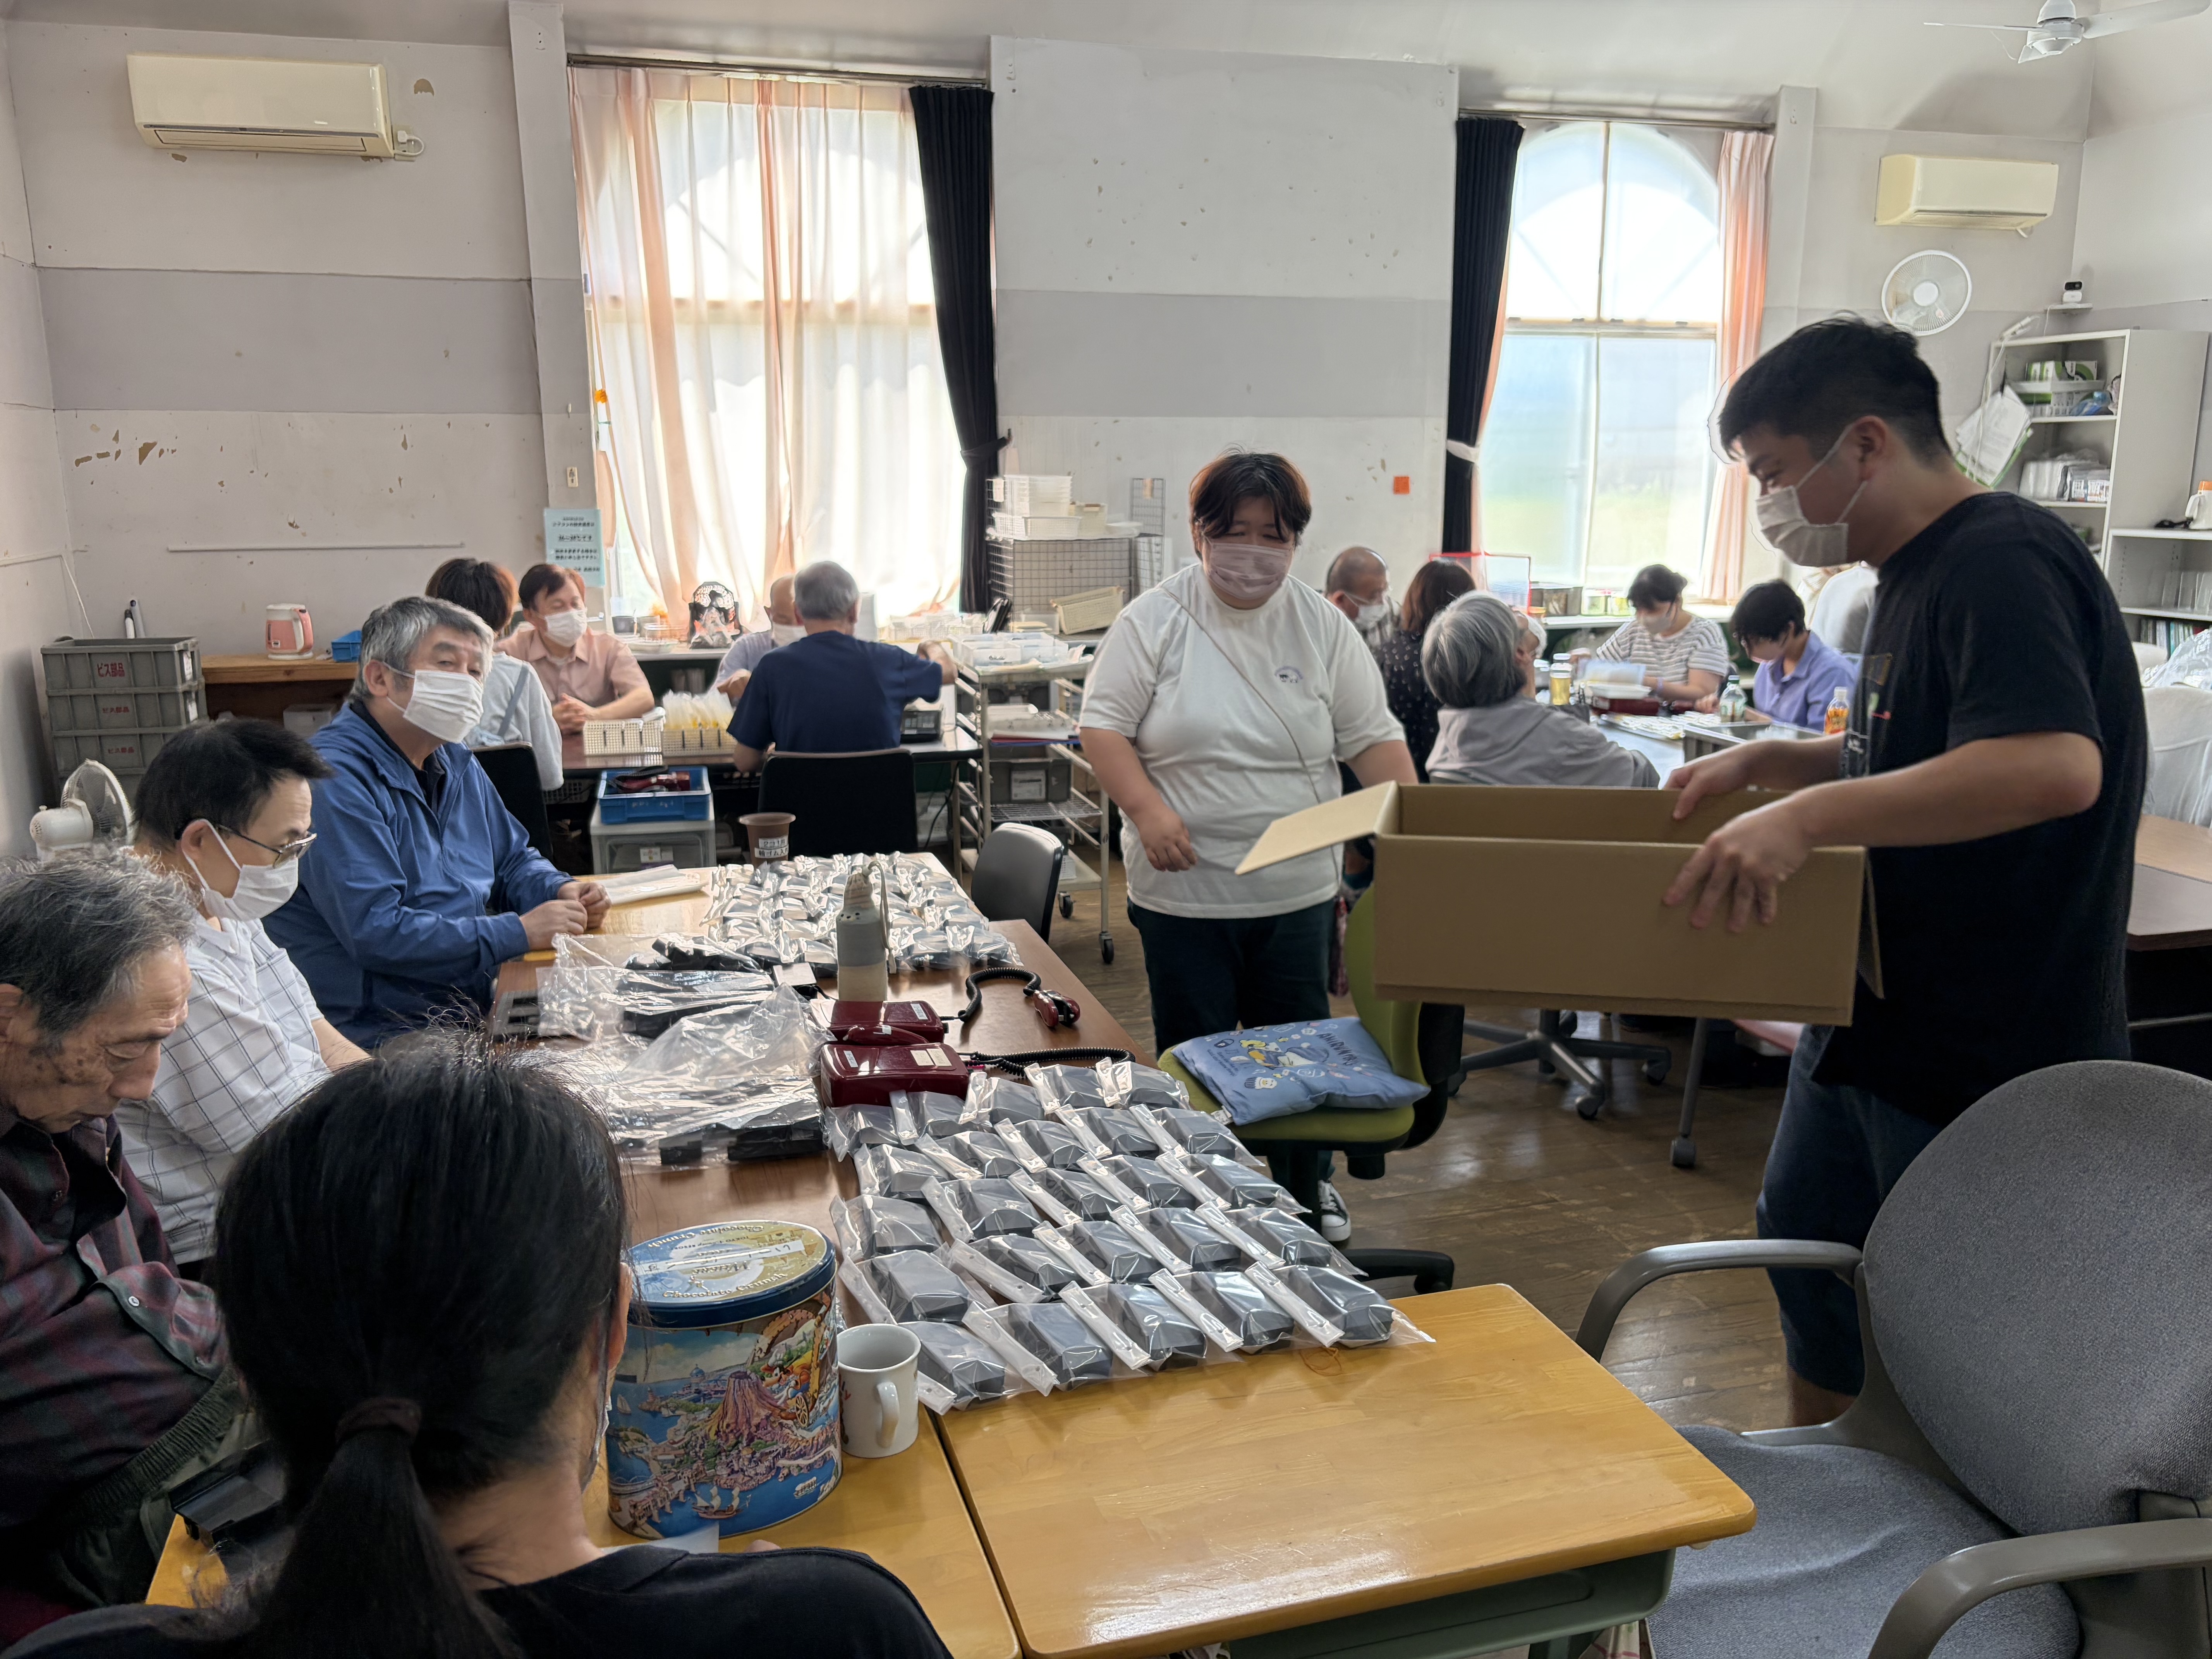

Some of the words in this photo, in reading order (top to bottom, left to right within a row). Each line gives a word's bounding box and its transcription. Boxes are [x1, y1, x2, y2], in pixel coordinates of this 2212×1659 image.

[97, 662, 125, 677] ビス部品
[699, 1225, 764, 1235] Chocolate
[648, 1231, 696, 1248] Crunch
[663, 1289, 733, 1298] Chocolate
[736, 1273, 788, 1291] Crunch
